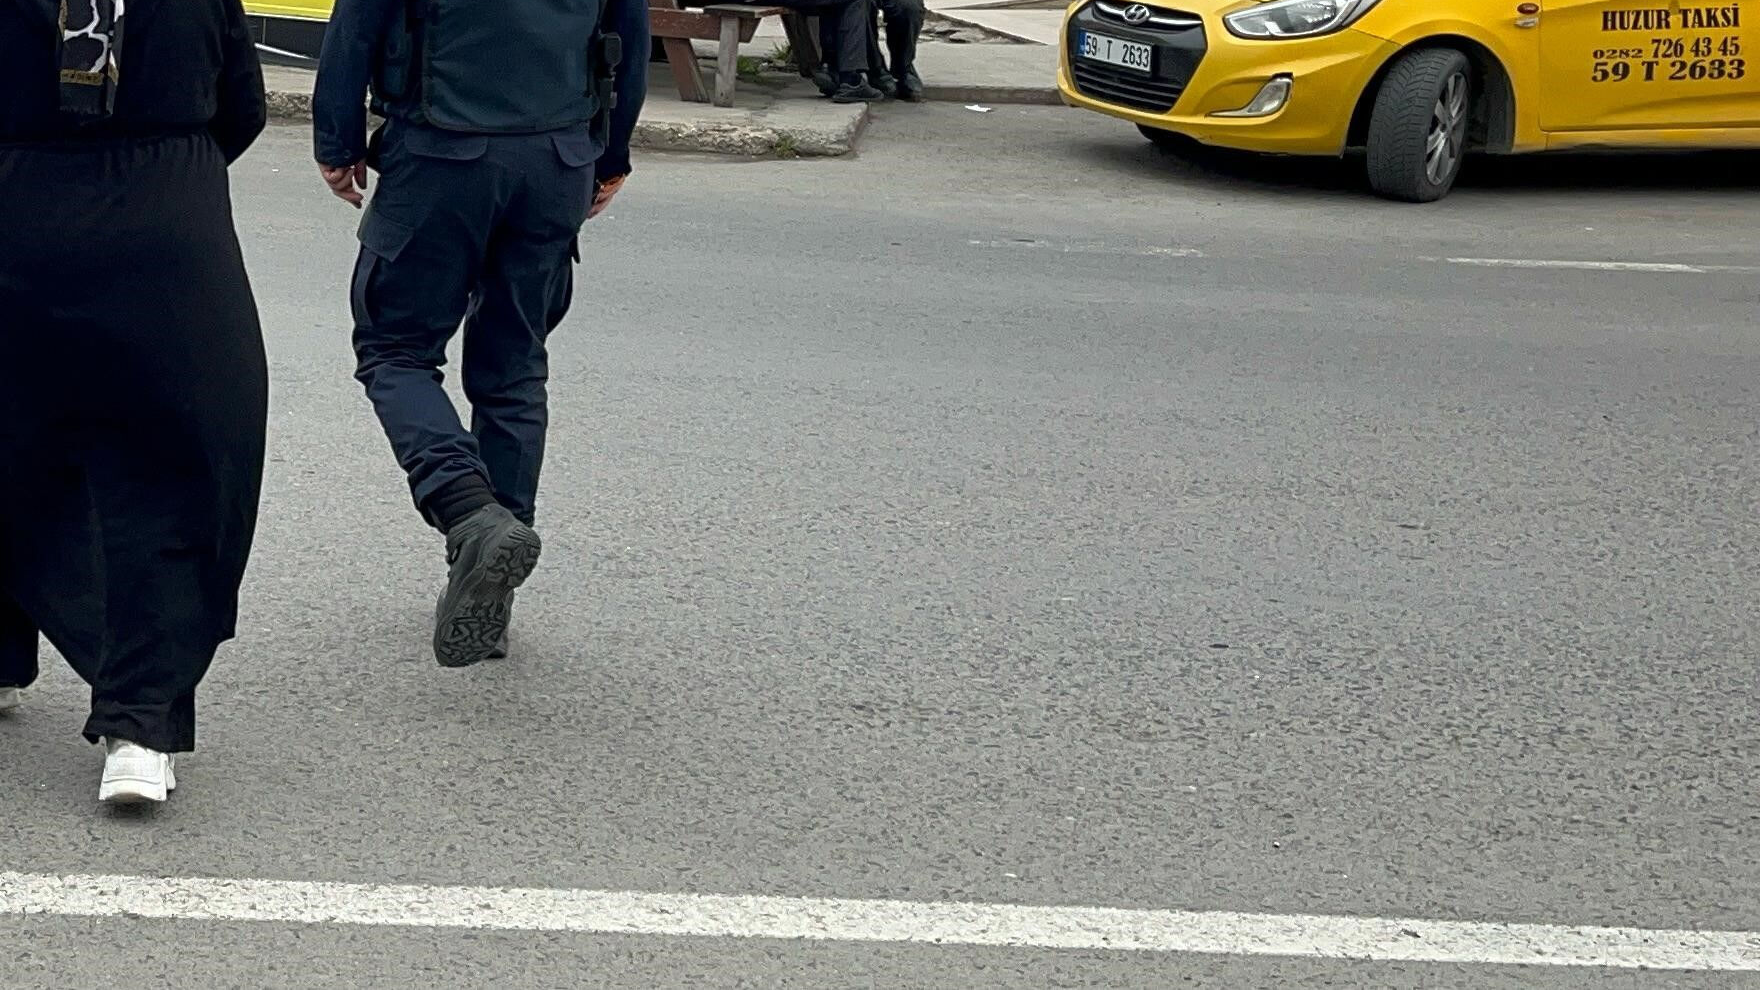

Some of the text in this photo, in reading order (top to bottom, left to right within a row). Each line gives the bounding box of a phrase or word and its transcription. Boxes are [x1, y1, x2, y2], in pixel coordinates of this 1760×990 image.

[1602, 3, 1740, 31] HUZUR TAKSİ
[1085, 35, 1149, 68] 59 T 2633
[1593, 36, 1740, 59] 0282 726 43 45
[1591, 58, 1746, 83] 59 T 2633
